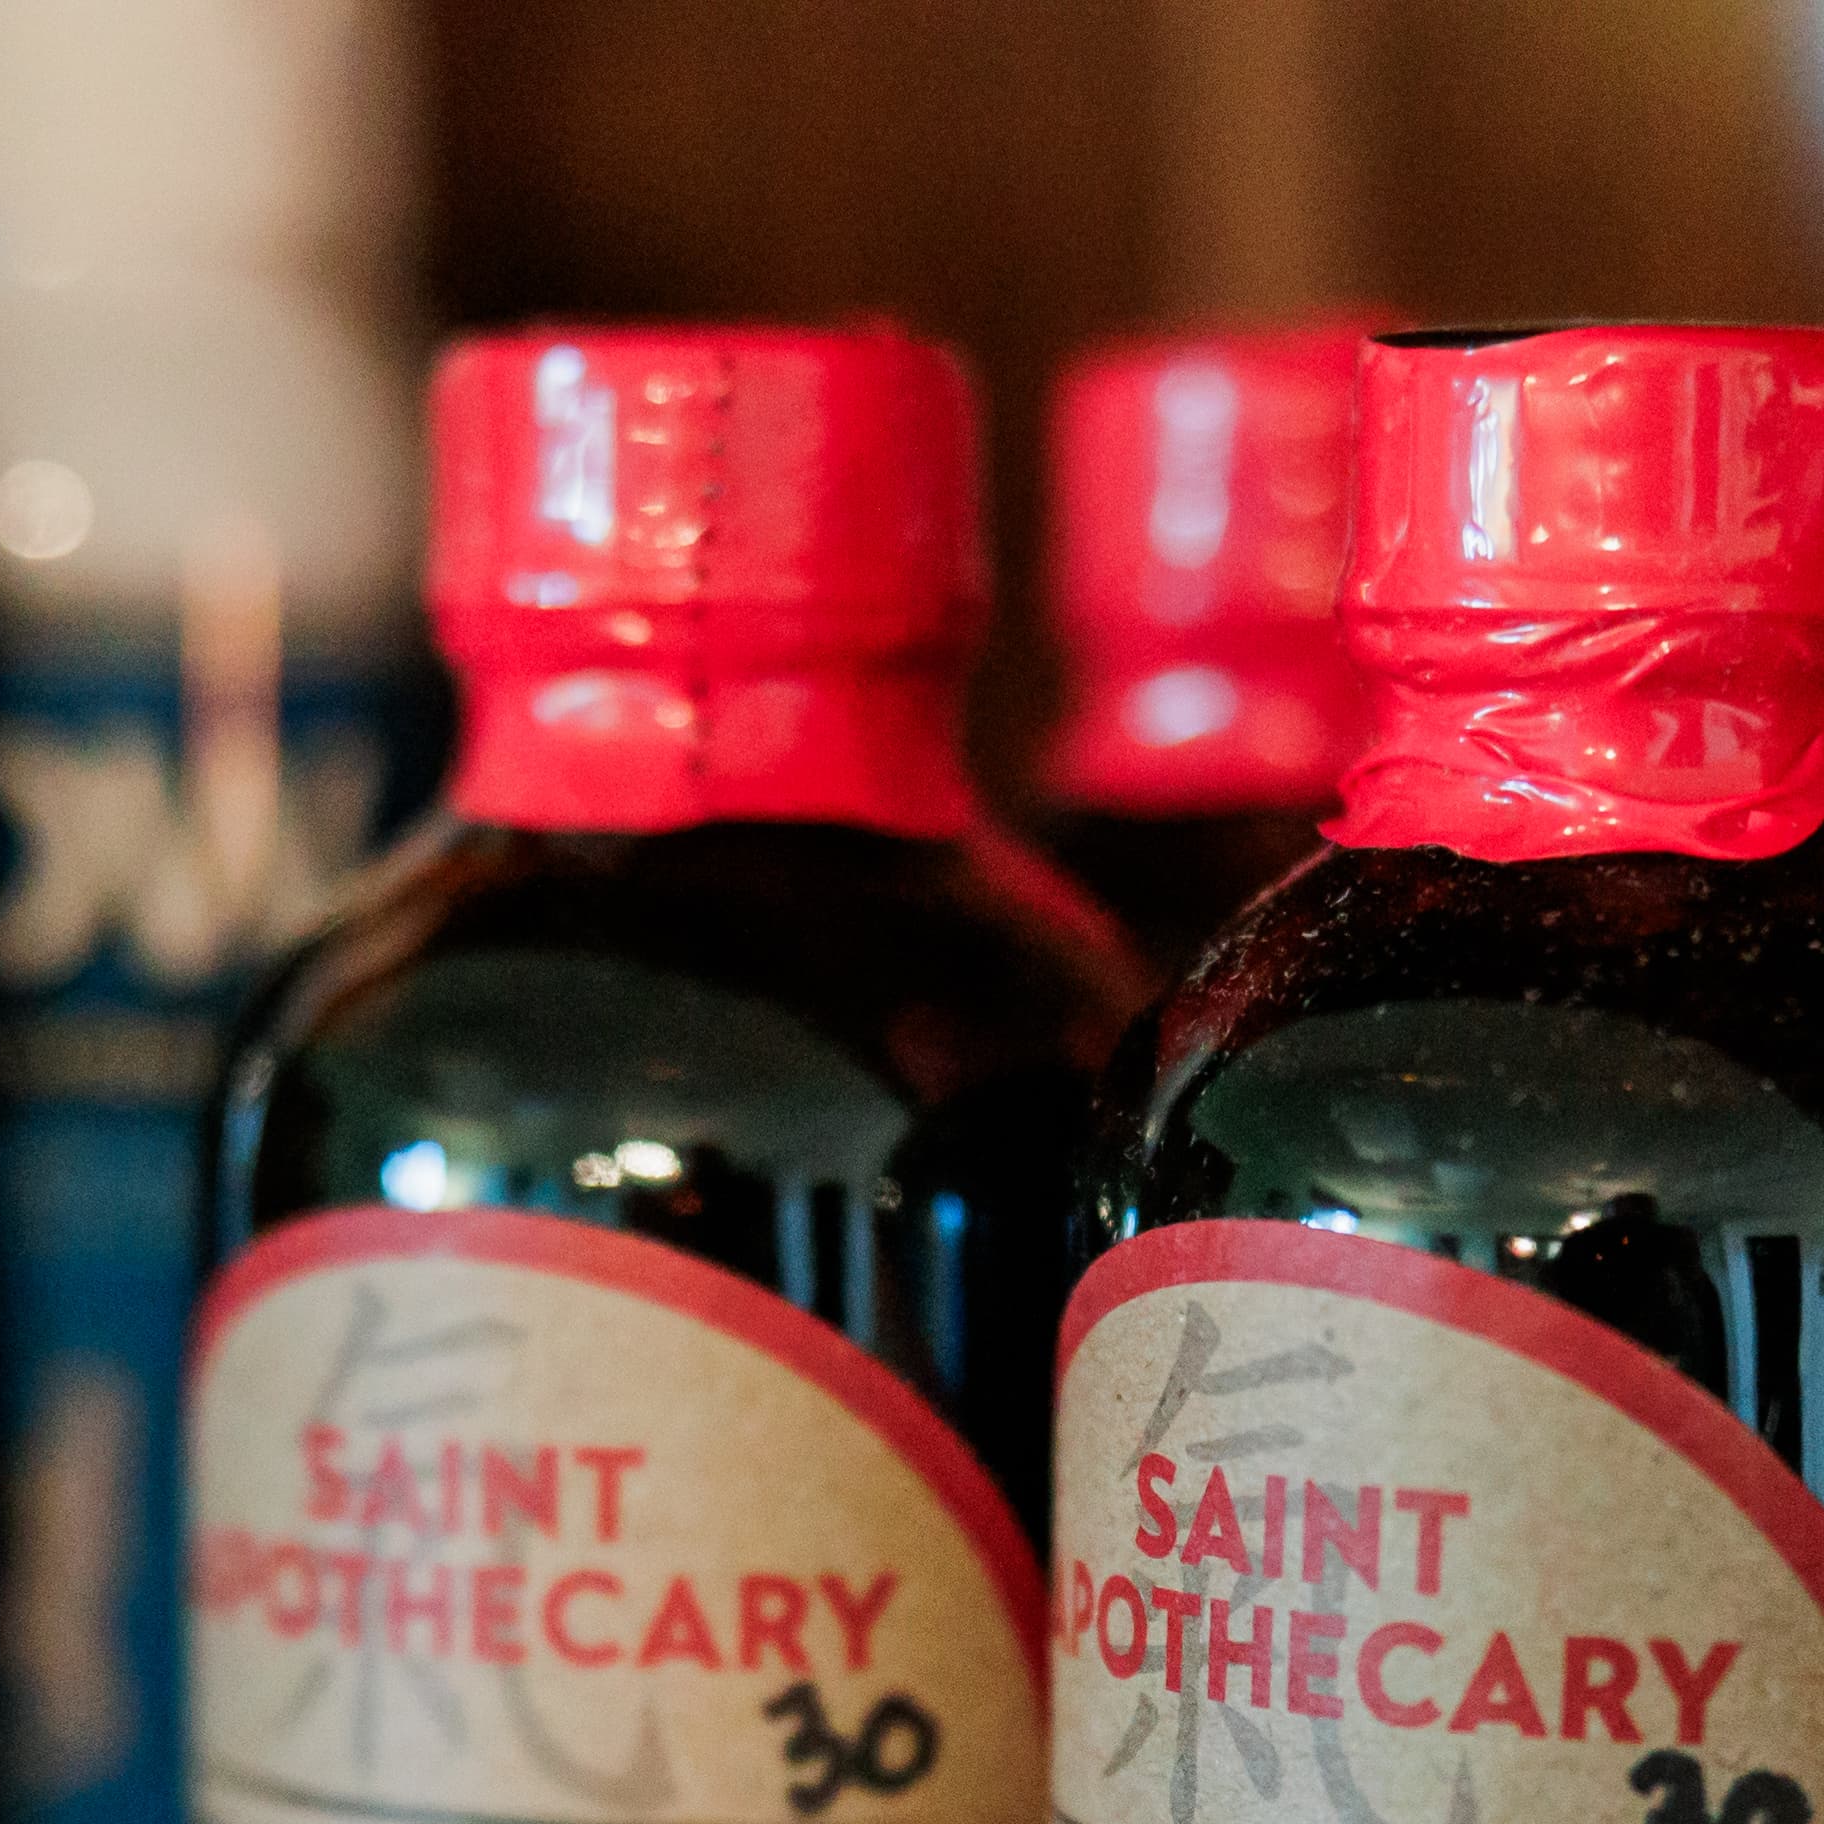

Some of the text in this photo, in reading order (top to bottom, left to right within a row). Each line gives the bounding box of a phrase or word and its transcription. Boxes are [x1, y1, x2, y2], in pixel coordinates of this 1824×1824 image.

[301, 1422, 647, 1542] SAINT
[1134, 1451, 1470, 1597] SAINT
[764, 1678, 939, 1816] 30
